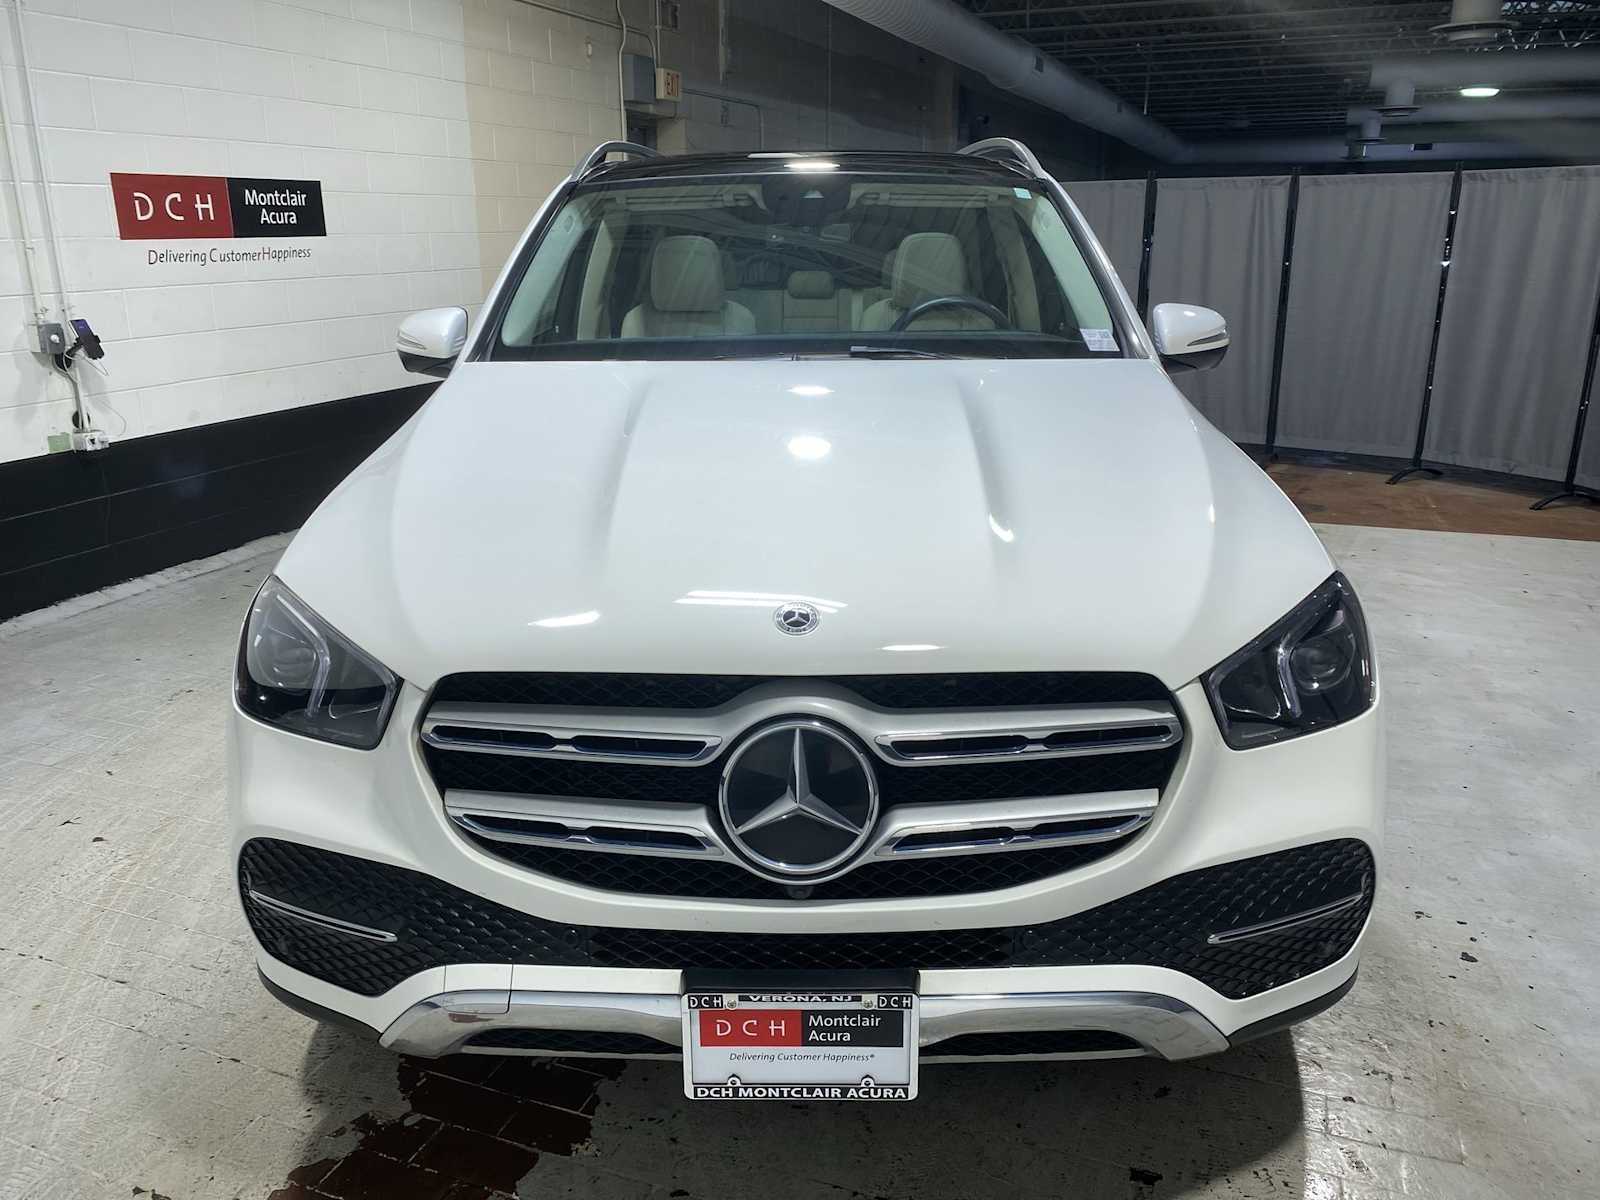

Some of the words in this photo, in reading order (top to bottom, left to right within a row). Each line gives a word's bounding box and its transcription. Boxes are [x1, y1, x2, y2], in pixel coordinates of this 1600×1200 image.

[244, 188, 307, 207] Montclair
[260, 207, 298, 225] Acura
[147, 249, 207, 266] Delivering
[689, 996, 722, 1008] DCH
[879, 996, 912, 1008] DCH
[808, 1014, 881, 1027] Montclair
[716, 1019, 785, 1037] DCH
[808, 1030, 851, 1042] Acura
[729, 1052, 775, 1063] Delivering
[777, 1052, 820, 1061] Customer
[696, 1087, 733, 1098] DCH
[738, 1087, 842, 1098] MONTCLAIR
[846, 1087, 907, 1098] ACURA
